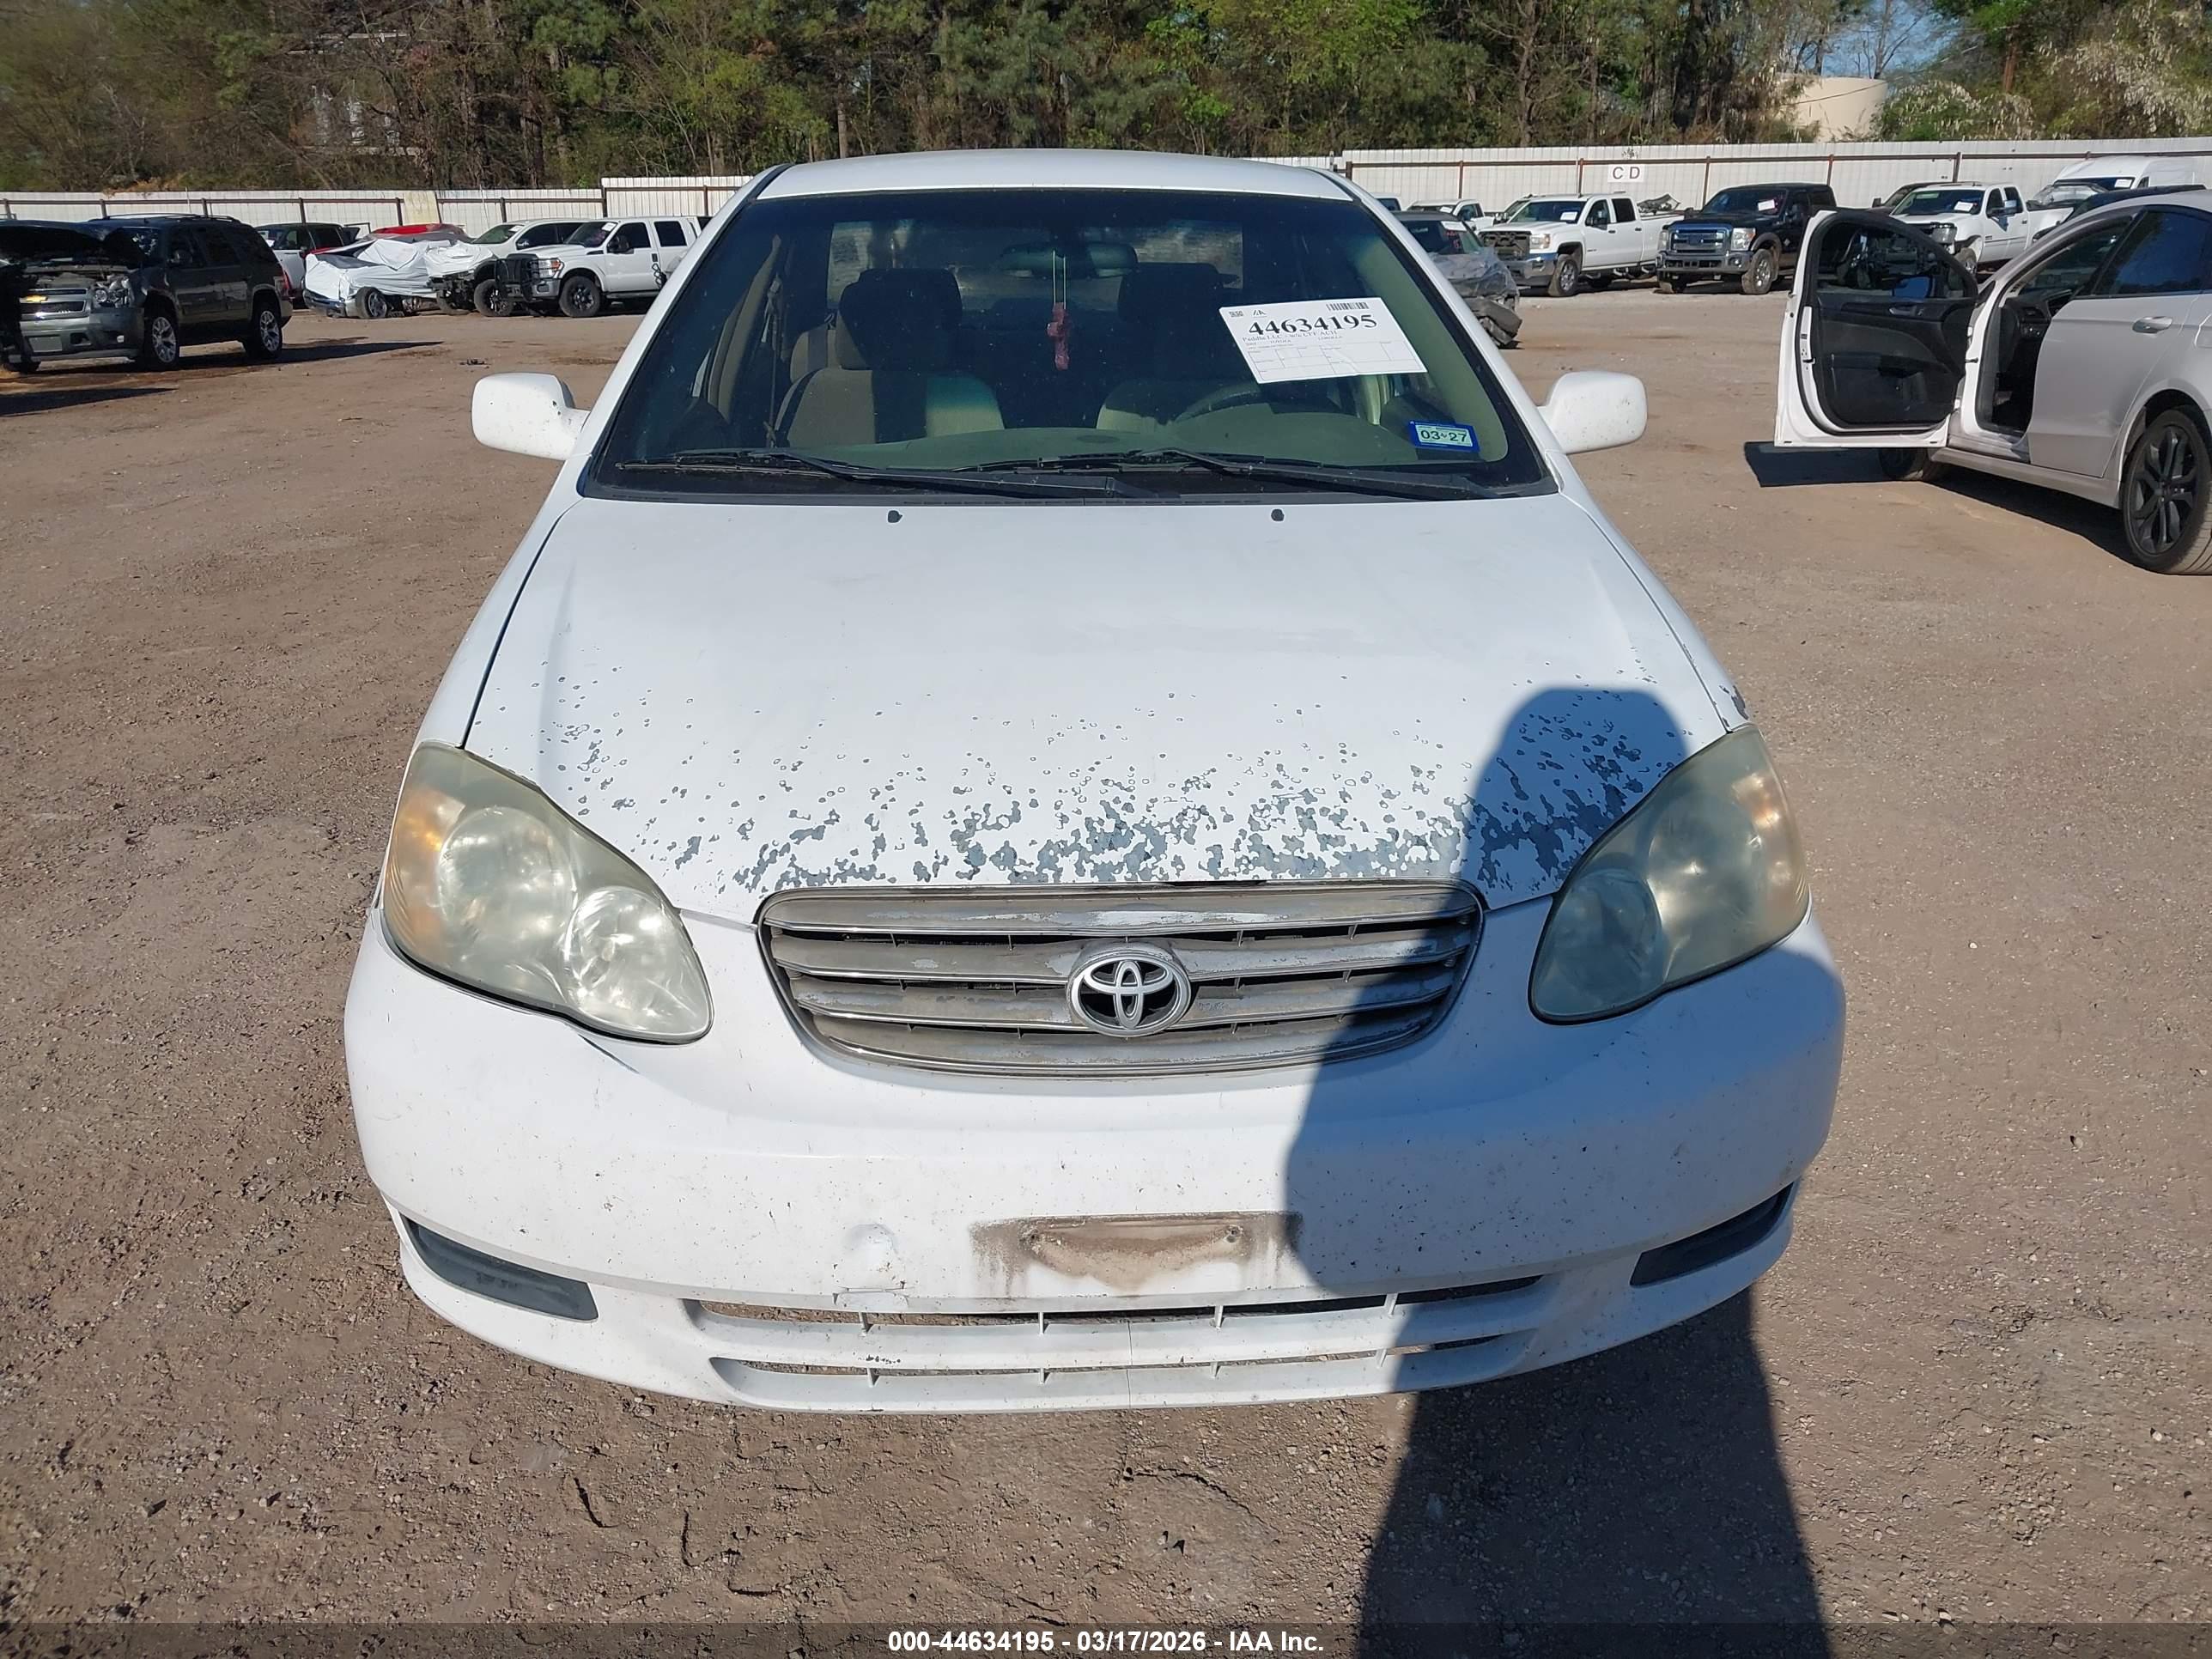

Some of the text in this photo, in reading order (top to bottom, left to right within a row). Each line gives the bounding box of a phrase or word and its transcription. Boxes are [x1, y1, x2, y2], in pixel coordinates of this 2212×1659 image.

[1613, 166, 1640, 179] C D
[1249, 314, 1377, 336] 44634195
[1420, 430, 1467, 442] 03 27
